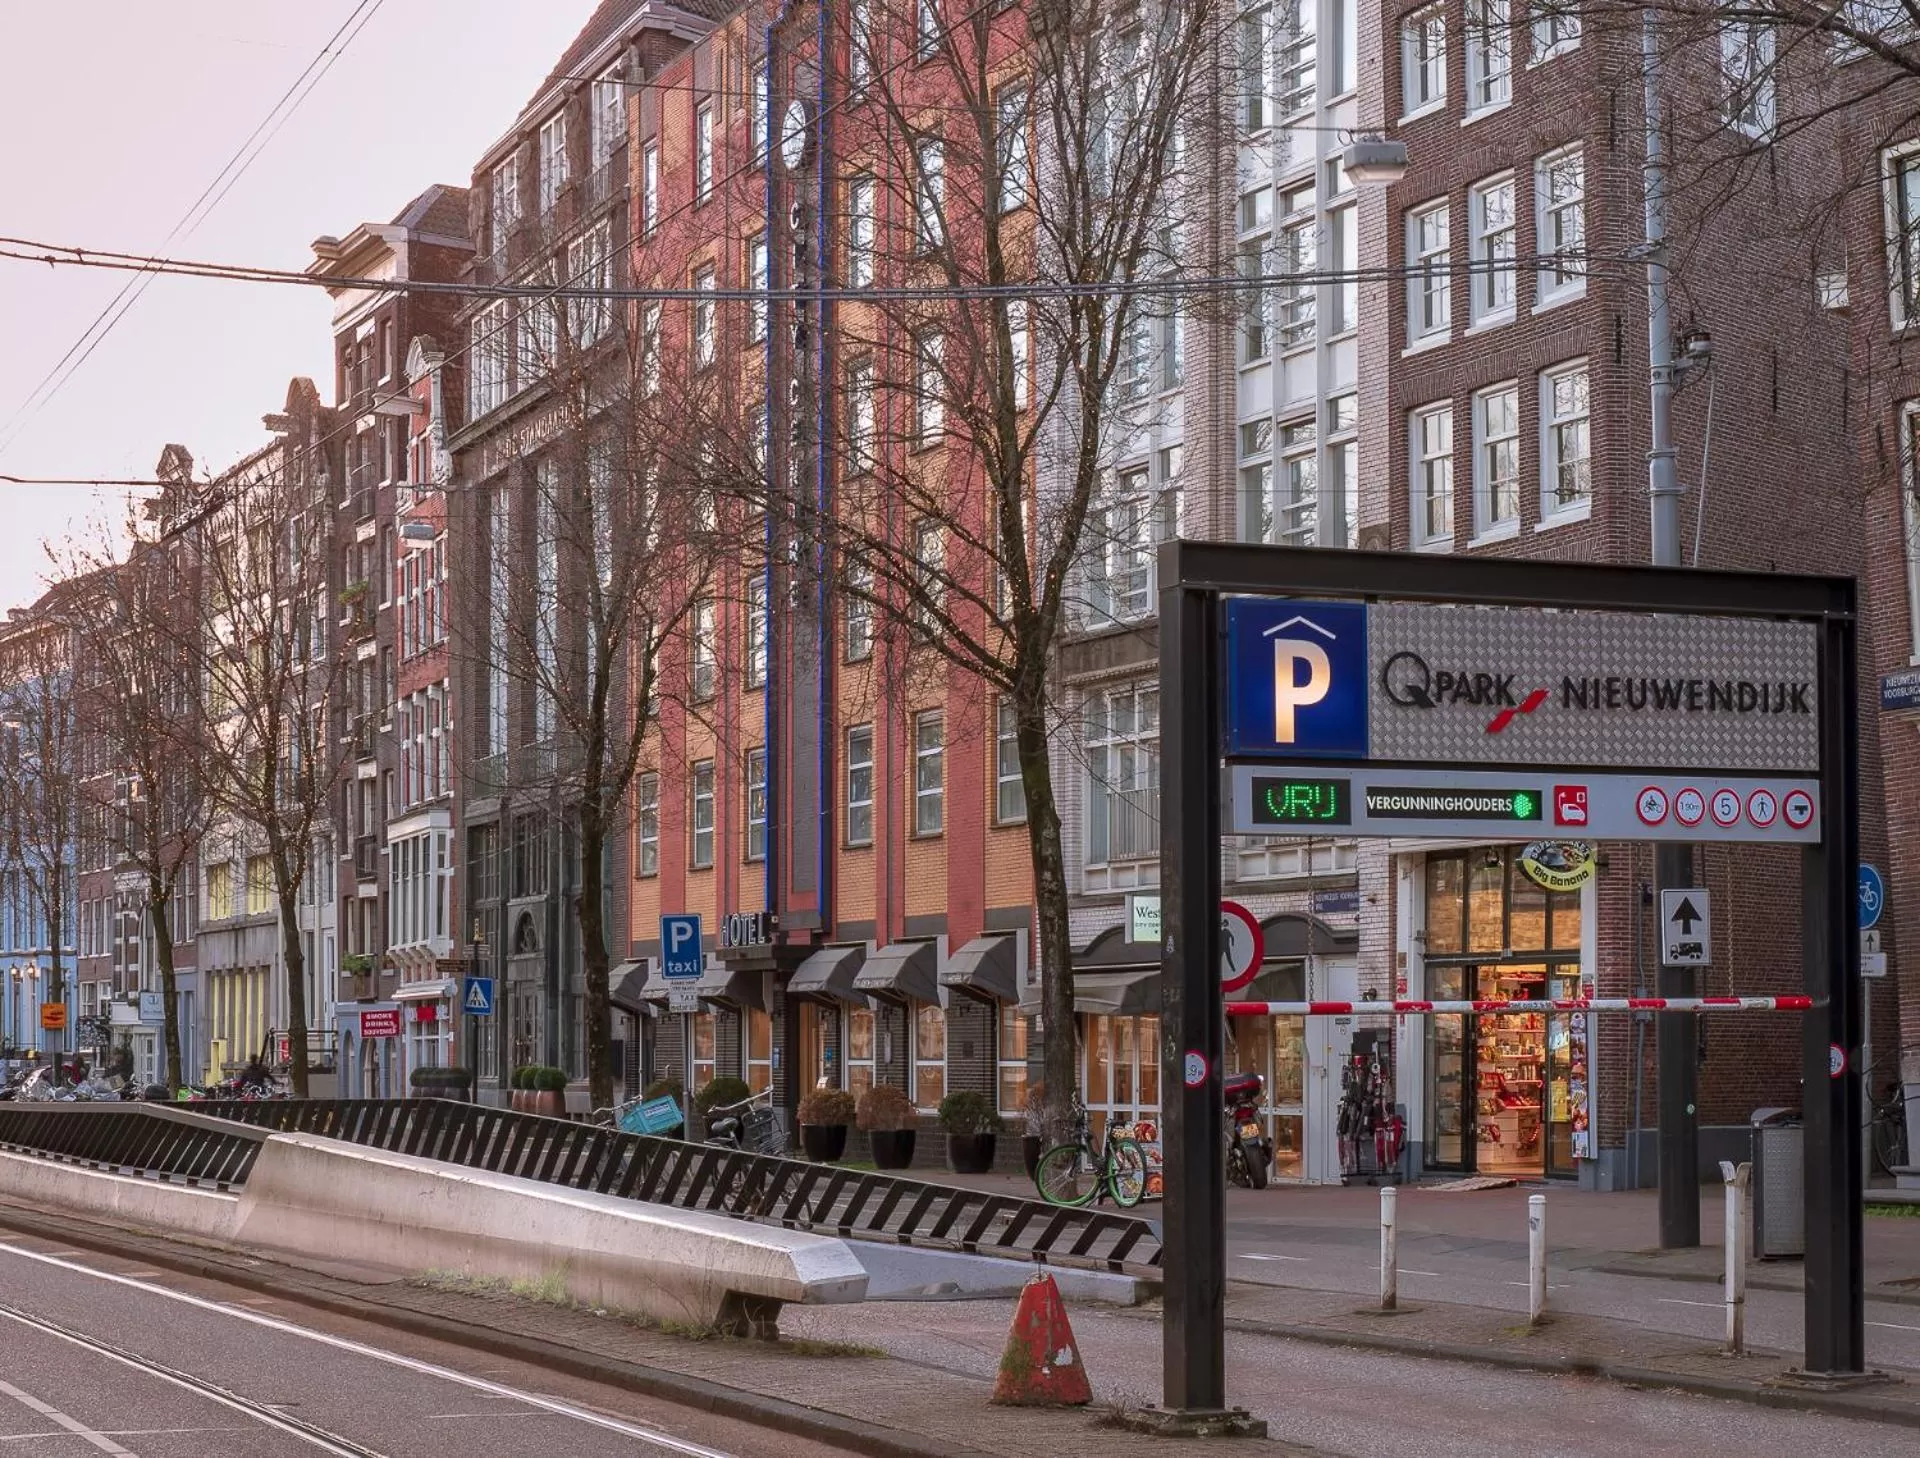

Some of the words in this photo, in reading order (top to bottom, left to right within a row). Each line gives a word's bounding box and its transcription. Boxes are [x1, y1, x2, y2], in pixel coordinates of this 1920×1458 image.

[1274, 638, 1331, 743] P
[1561, 675, 1812, 714] NIEUWENDIJK
[1366, 795, 1513, 812] VERGUNNINGHOUDERS
[1720, 798, 1732, 816] 5
[1533, 865, 1549, 882] Big
[1550, 870, 1590, 886] Banana
[671, 921, 693, 953] P
[720, 912, 765, 947] HOTEL
[667, 960, 698, 973] taxi
